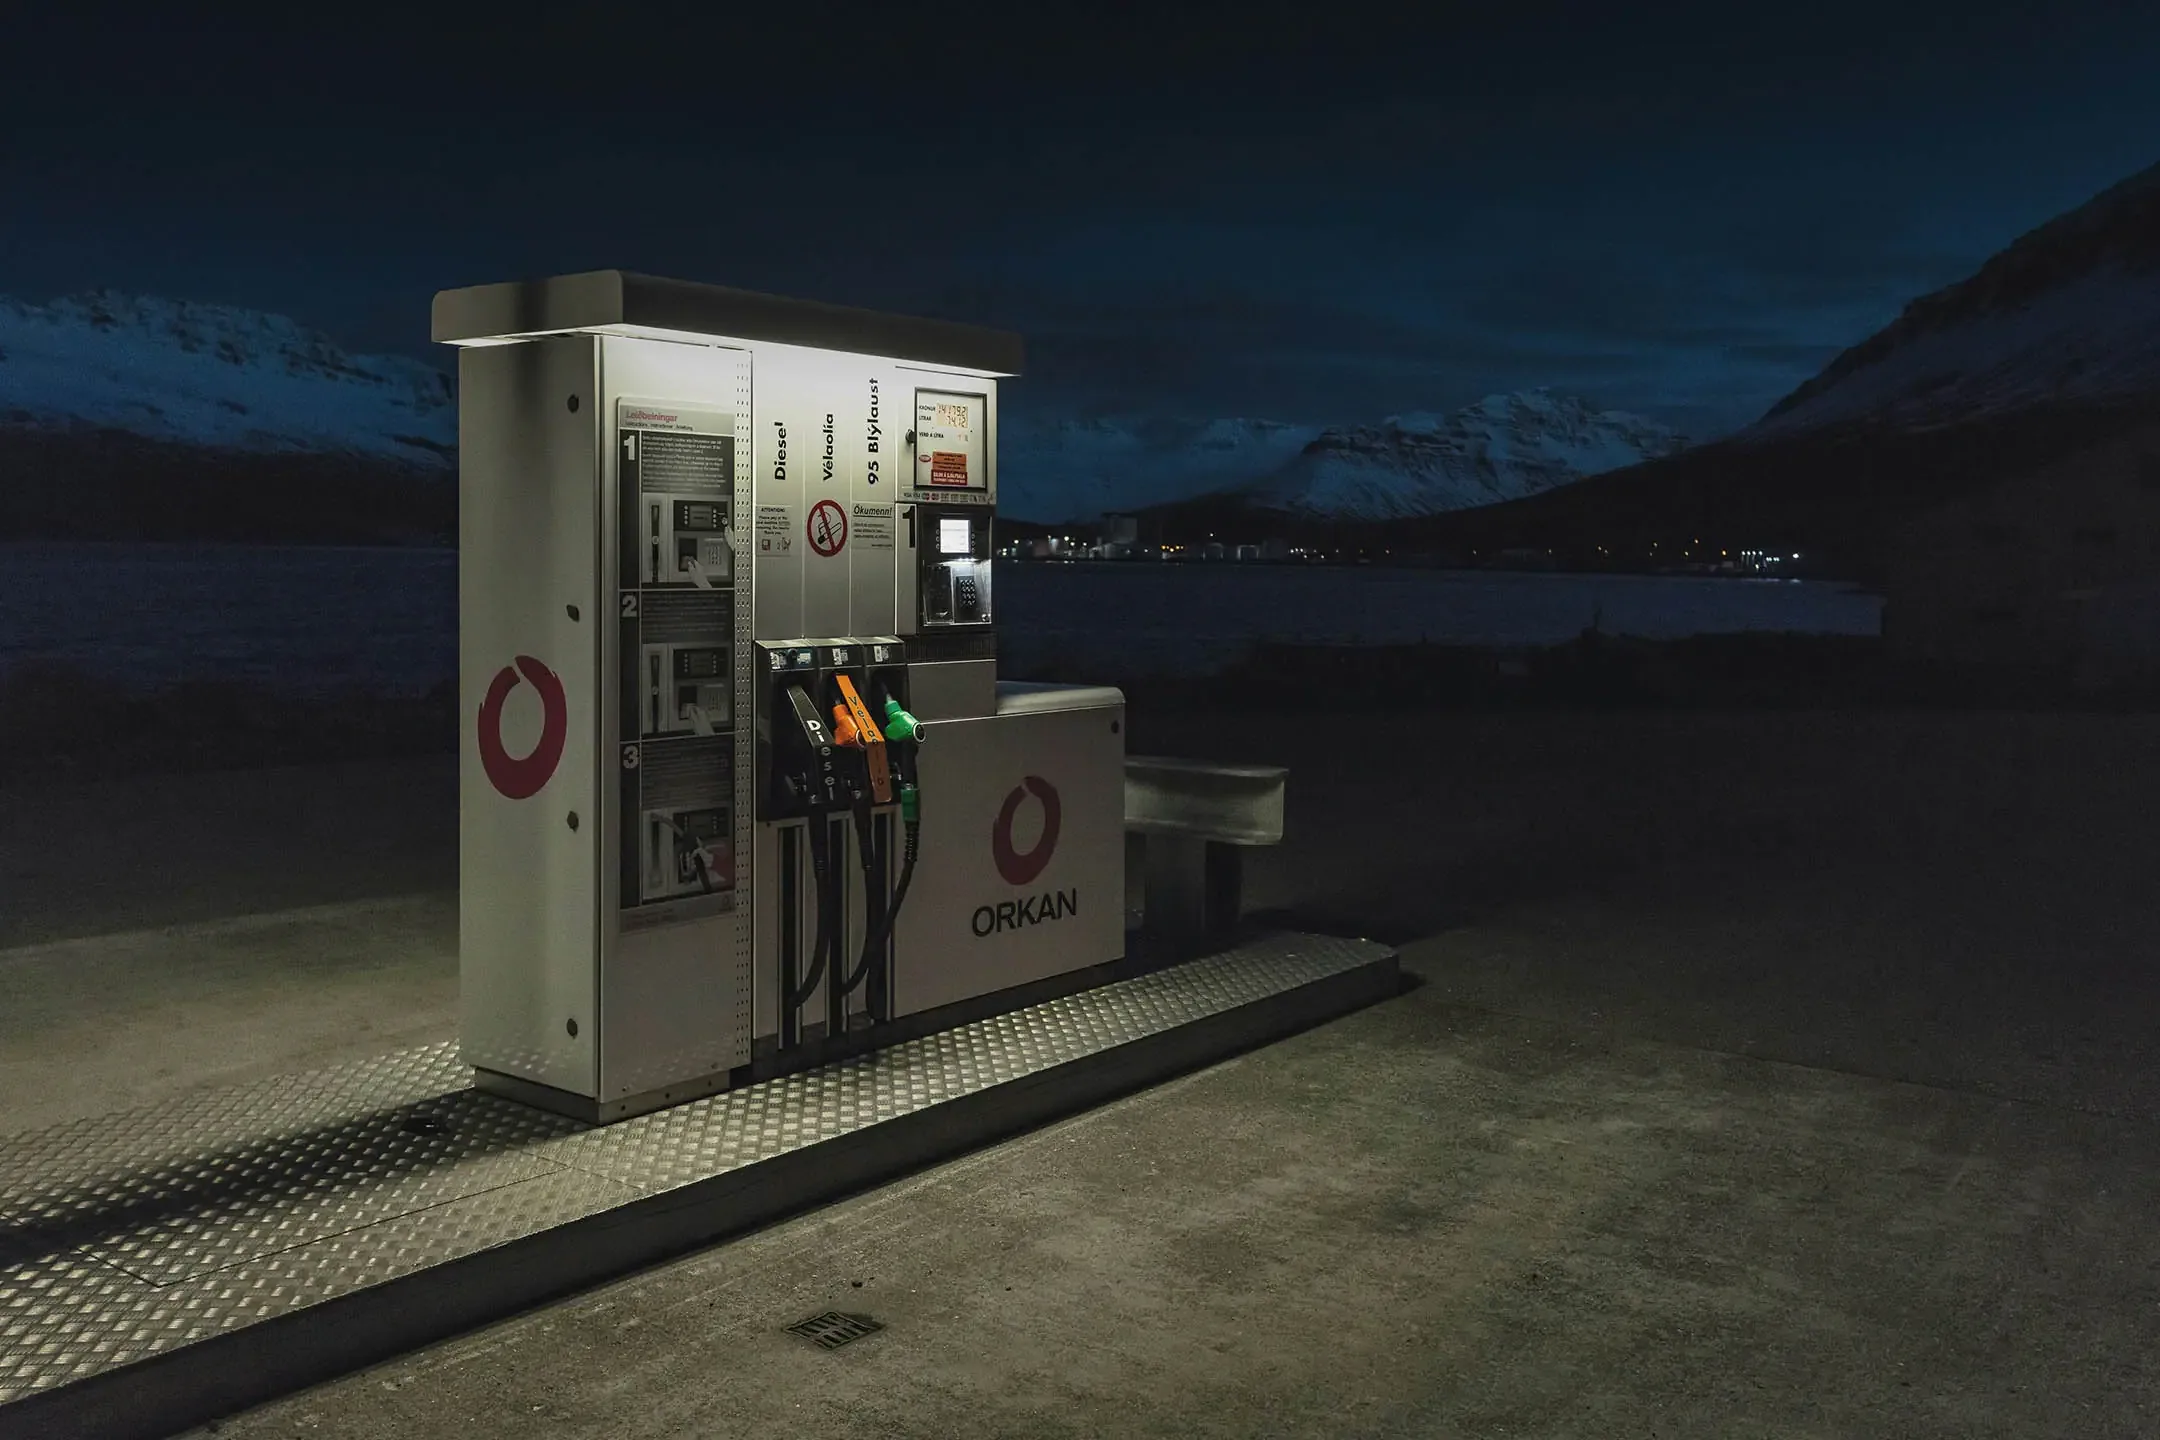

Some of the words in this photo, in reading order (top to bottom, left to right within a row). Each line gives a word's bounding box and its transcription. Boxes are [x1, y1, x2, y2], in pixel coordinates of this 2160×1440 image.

[867, 377, 882, 453] Blýlaust
[623, 435, 635, 461] 1
[774, 421, 787, 481] Diesel
[822, 413, 834, 481] Vélaolía
[867, 460, 879, 485] 95
[853, 503, 893, 516] Ökumenn!
[902, 505, 916, 549] 1
[622, 594, 637, 618] 2
[623, 745, 639, 769] 3
[806, 719, 835, 801] Diesel
[971, 887, 1078, 938] ORKAN
